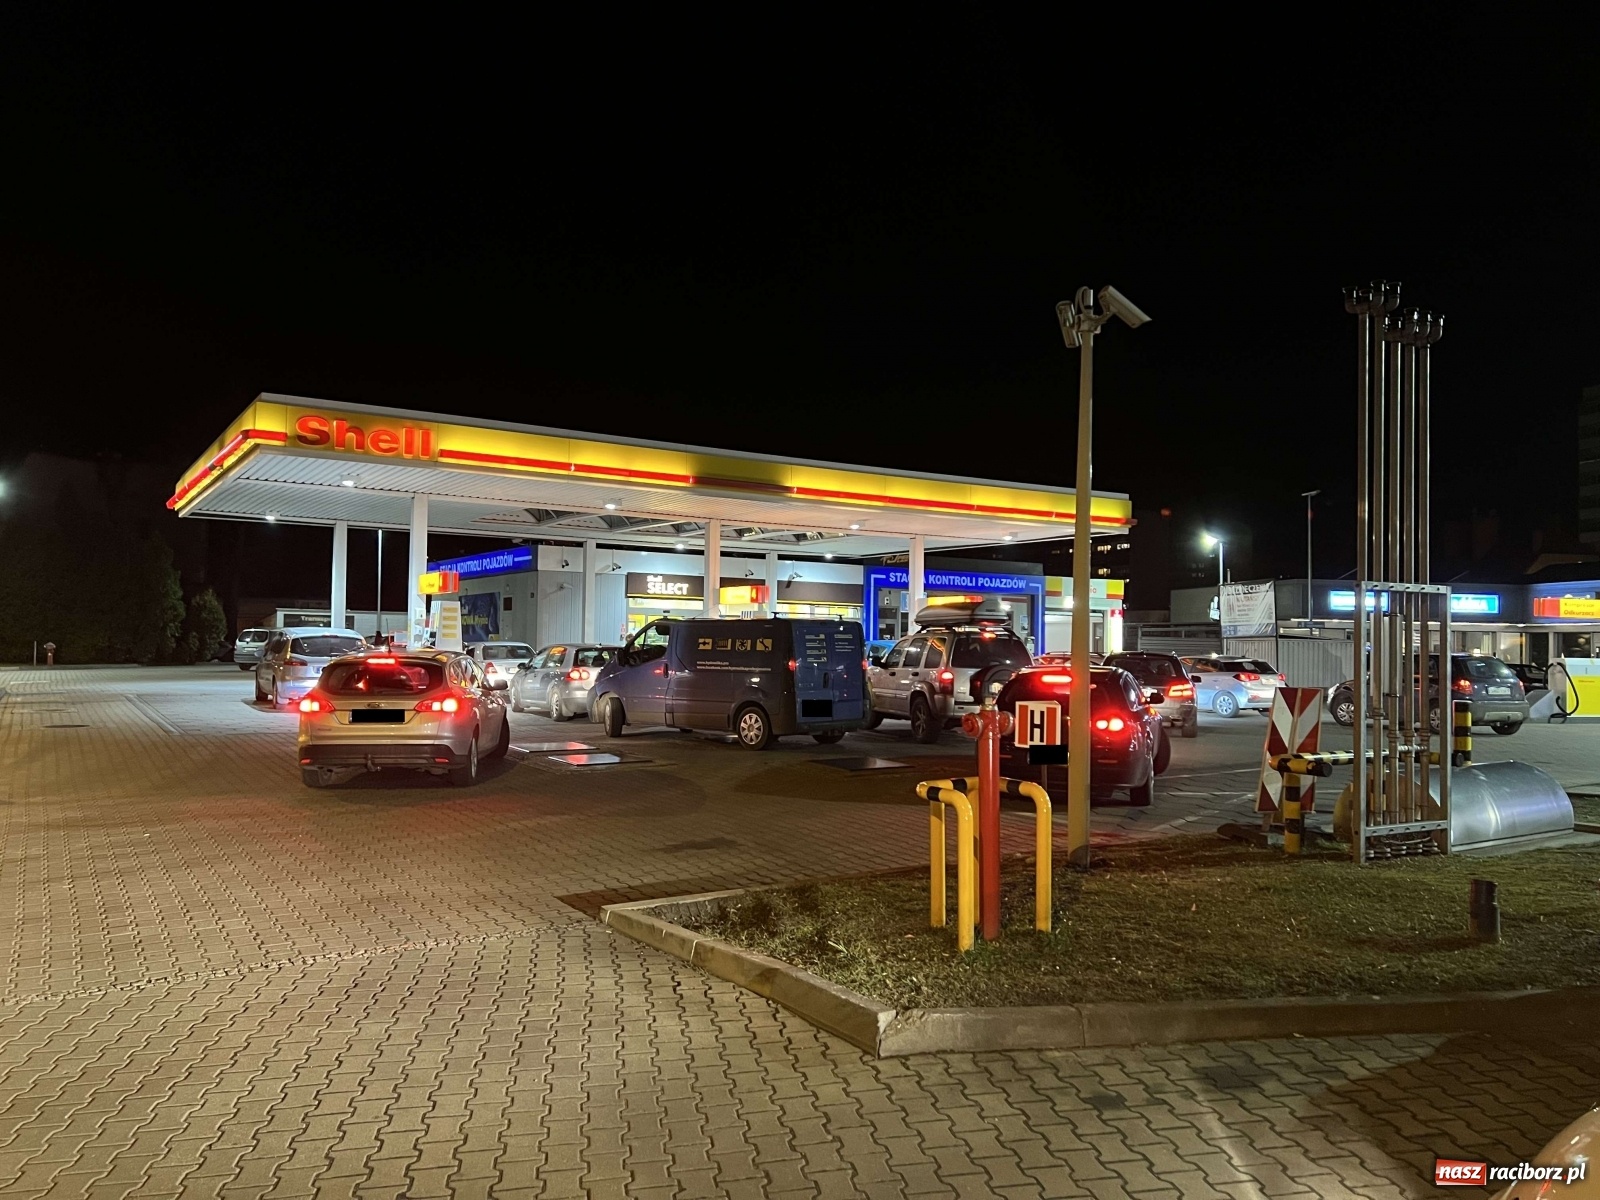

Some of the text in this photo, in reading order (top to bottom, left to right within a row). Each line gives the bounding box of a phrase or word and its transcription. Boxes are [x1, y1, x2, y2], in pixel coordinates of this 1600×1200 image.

[295, 415, 432, 459] Shell
[457, 559, 482, 574] KONTROLI
[482, 552, 514, 571] POJAZDÓW
[646, 582, 689, 595] SELECT
[889, 572, 1027, 589] STA KONTROLI POJAZDÓW
[301, 615, 331, 623] Transp
[1030, 710, 1045, 743] H
